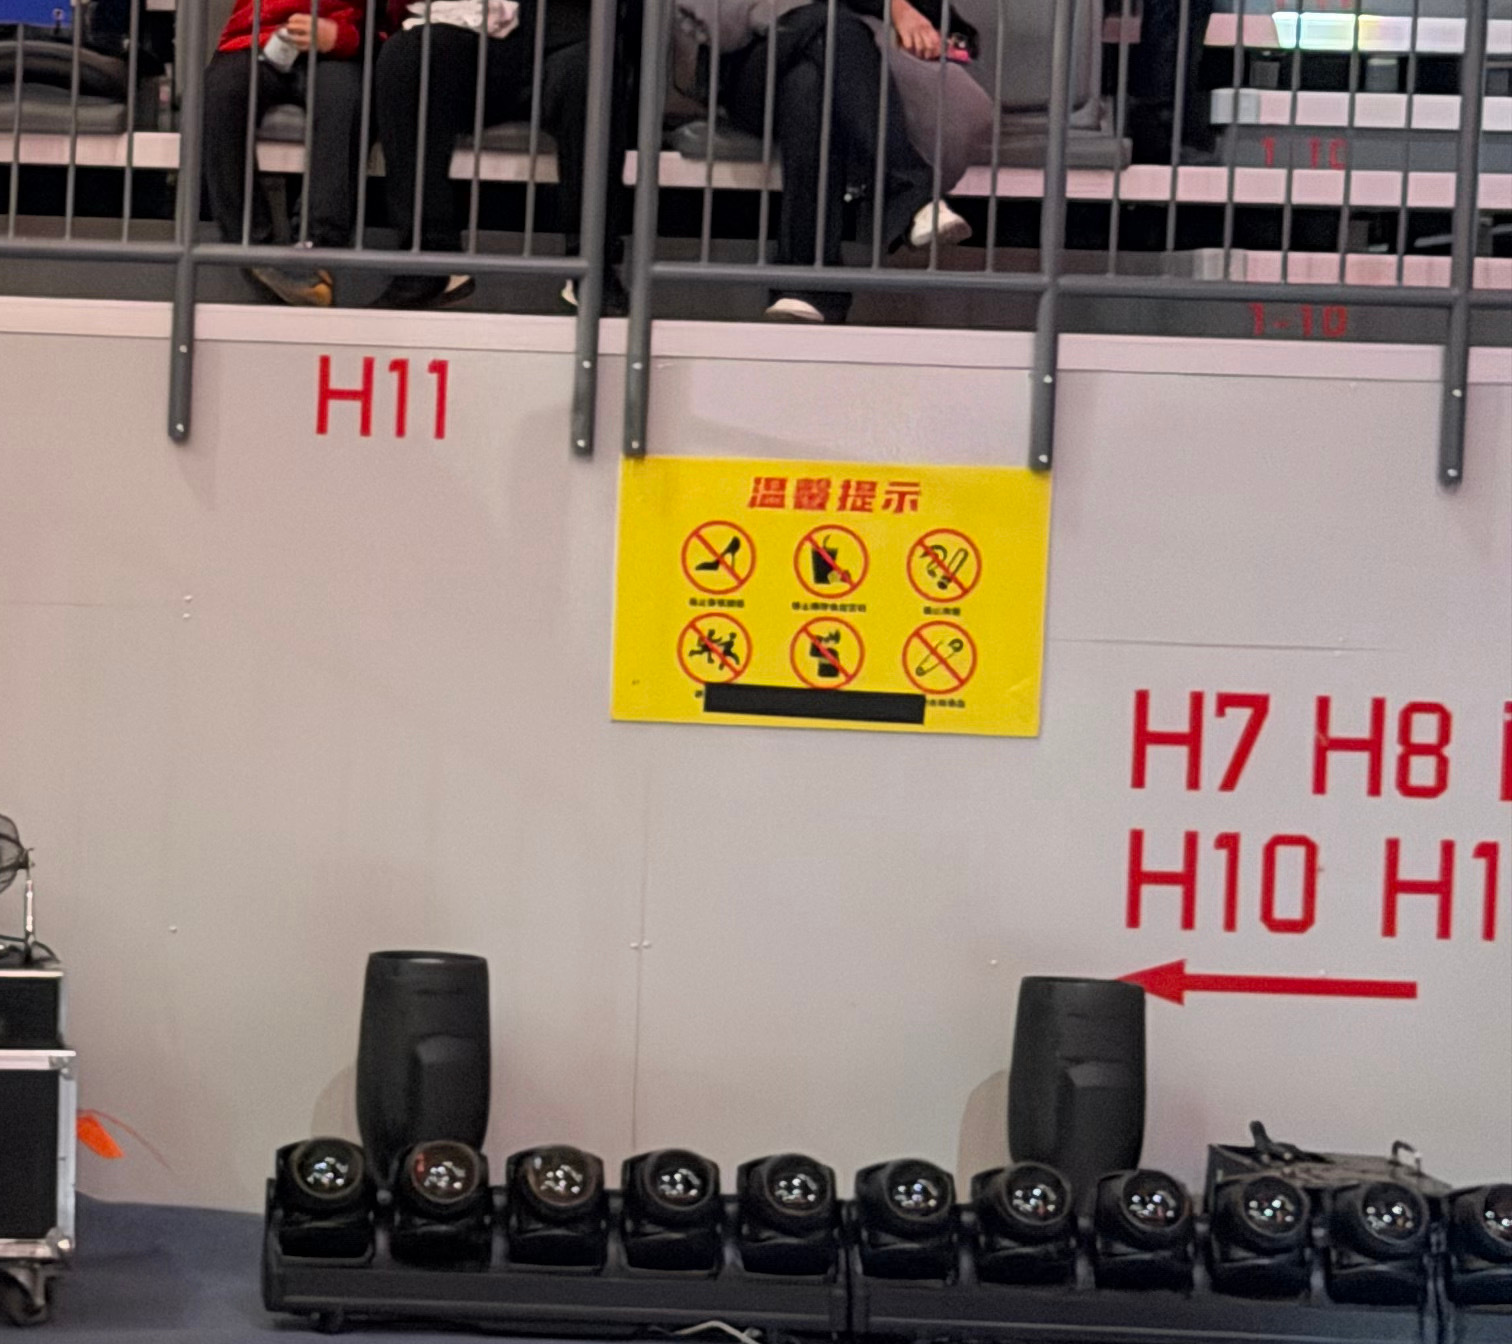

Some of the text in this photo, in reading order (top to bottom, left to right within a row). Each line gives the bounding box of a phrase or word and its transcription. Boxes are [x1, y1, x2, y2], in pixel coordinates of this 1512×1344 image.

[1249, 302, 1348, 337] 1-10
[316, 355, 449, 440] H11
[747, 476, 922, 514] 温馨提示
[1131, 689, 1270, 792] H7
[1312, 696, 1452, 799] H8
[1126, 828, 1500, 942] H10 H1
